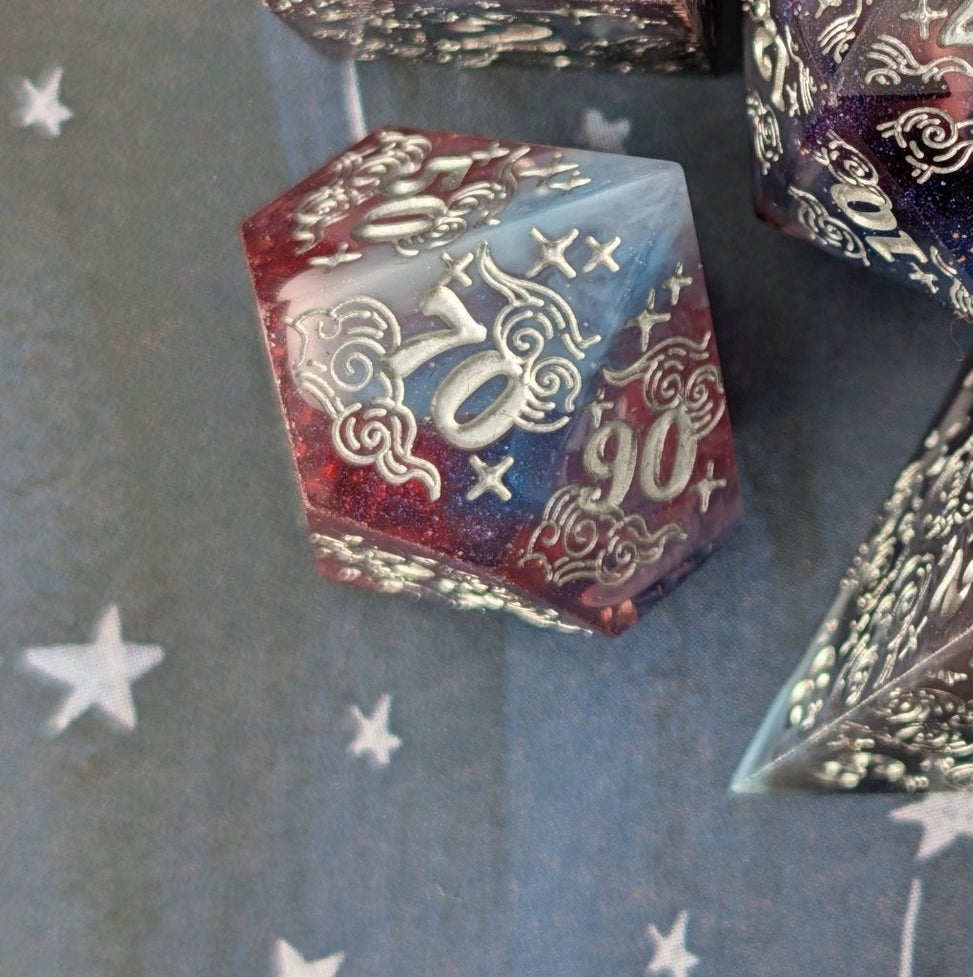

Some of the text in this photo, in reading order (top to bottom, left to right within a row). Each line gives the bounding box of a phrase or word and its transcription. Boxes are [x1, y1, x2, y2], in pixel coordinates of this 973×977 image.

[830, 183, 928, 263] 10
[390, 285, 528, 451] 70
[582, 409, 699, 511] 90
